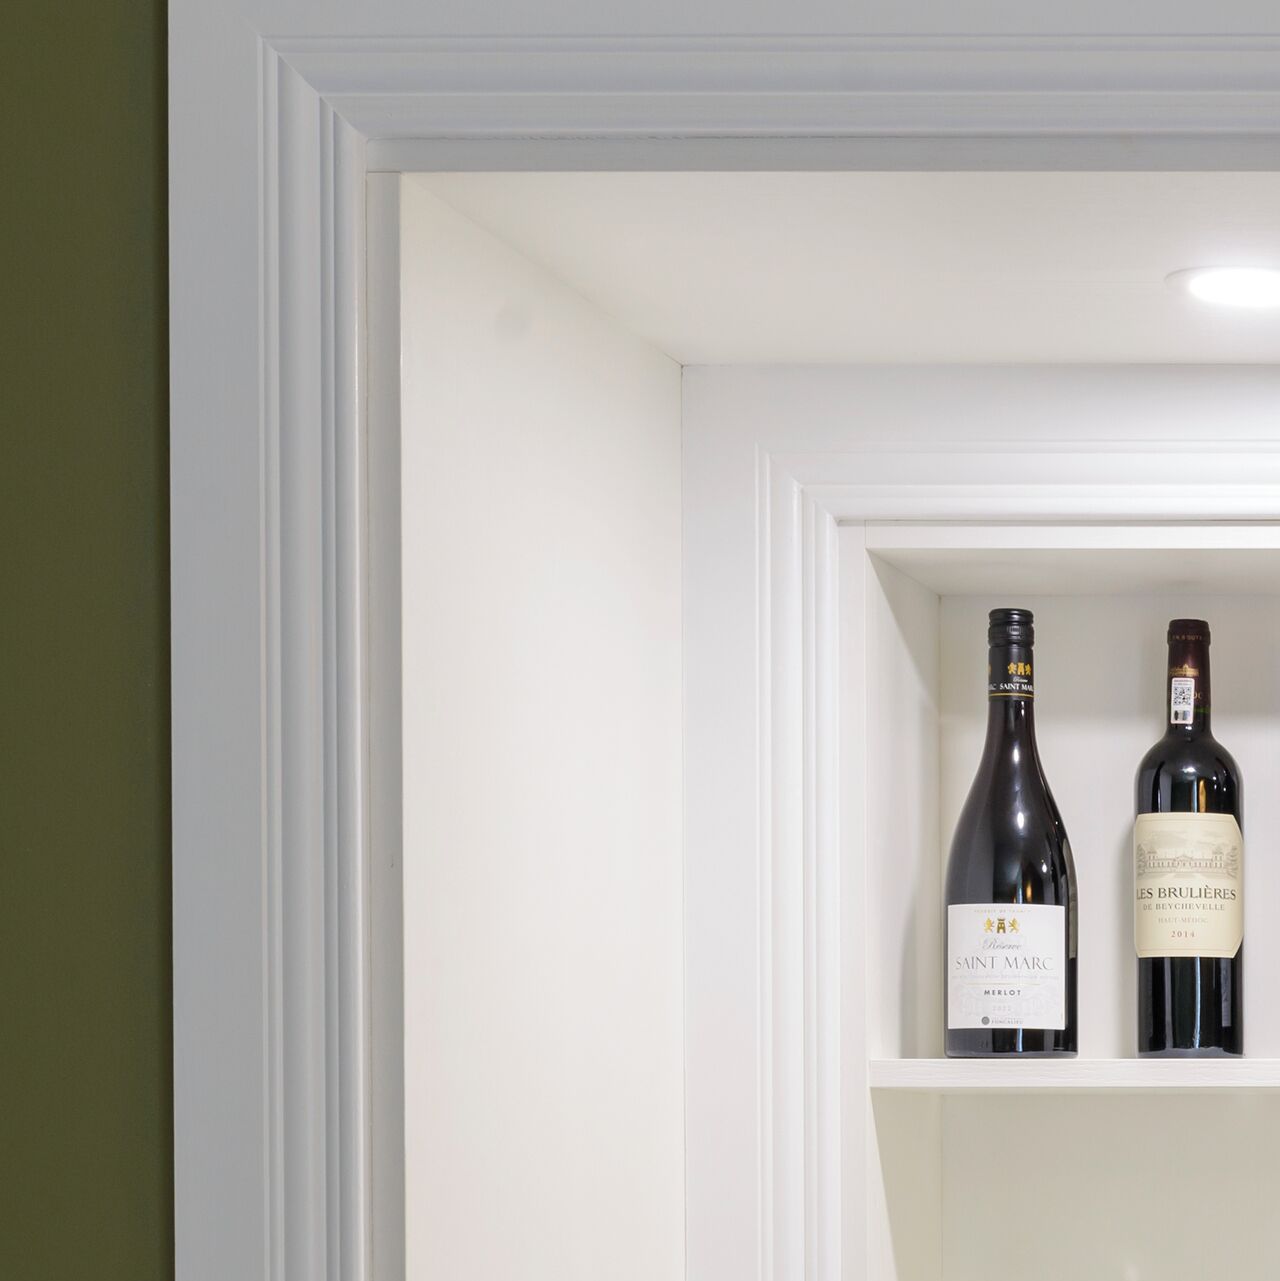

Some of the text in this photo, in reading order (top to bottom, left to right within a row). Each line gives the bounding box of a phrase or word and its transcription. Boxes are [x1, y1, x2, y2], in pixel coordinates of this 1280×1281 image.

[1136, 884, 1237, 901] LES BRULIÈRES
[1143, 903, 1225, 911] DE BEYCHEVELLE
[1171, 930, 1196, 938] 2014
[956, 956, 1054, 971] SAINT MARC
